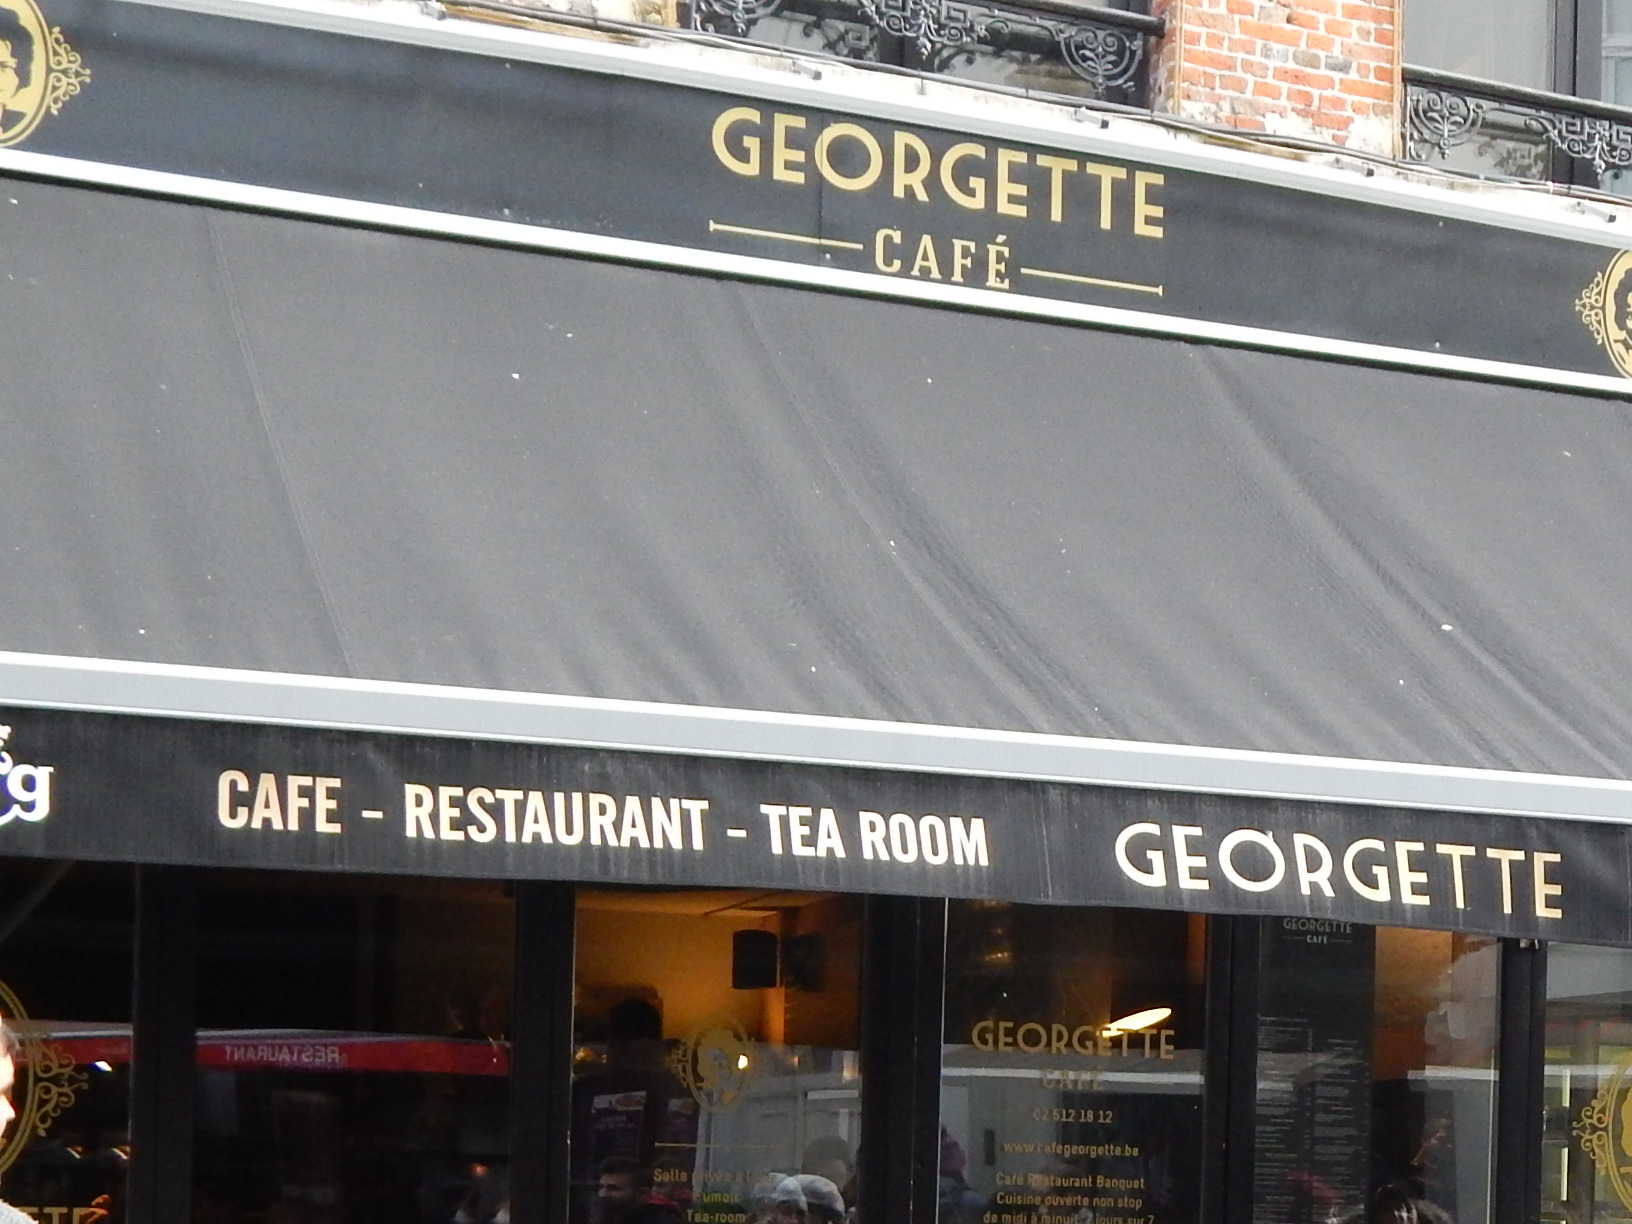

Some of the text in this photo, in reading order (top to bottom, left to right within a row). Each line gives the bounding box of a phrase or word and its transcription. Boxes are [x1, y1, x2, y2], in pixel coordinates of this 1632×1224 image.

[711, 106, 1165, 238] GEORGETTE
[874, 226, 1011, 290] CAFÉ
[217, 769, 342, 834] CAFE
[404, 782, 710, 851] RESTAURANT
[760, 803, 846, 859] TEA
[859, 811, 990, 867] ROOM
[1114, 821, 1563, 920] GEORGETTE
[1283, 917, 1352, 934] GEORGETTE
[972, 1020, 1175, 1060] GEORGETTE
[1052, 1108, 1076, 1122] 512
[1080, 1109, 1094, 1123] 18
[1098, 1110, 1113, 1124] 12
[1003, 1141, 1139, 1159] www.cafegeorgette.be
[653, 1167, 688, 1183] Salle
[1096, 1175, 1145, 1190] Banquet
[996, 1191, 1143, 1211] Cuisine ouverte non stop
[686, 1209, 746, 1223] Tea-room
[983, 1211, 998, 1223] de
[1001, 1212, 1027, 1224] midi
